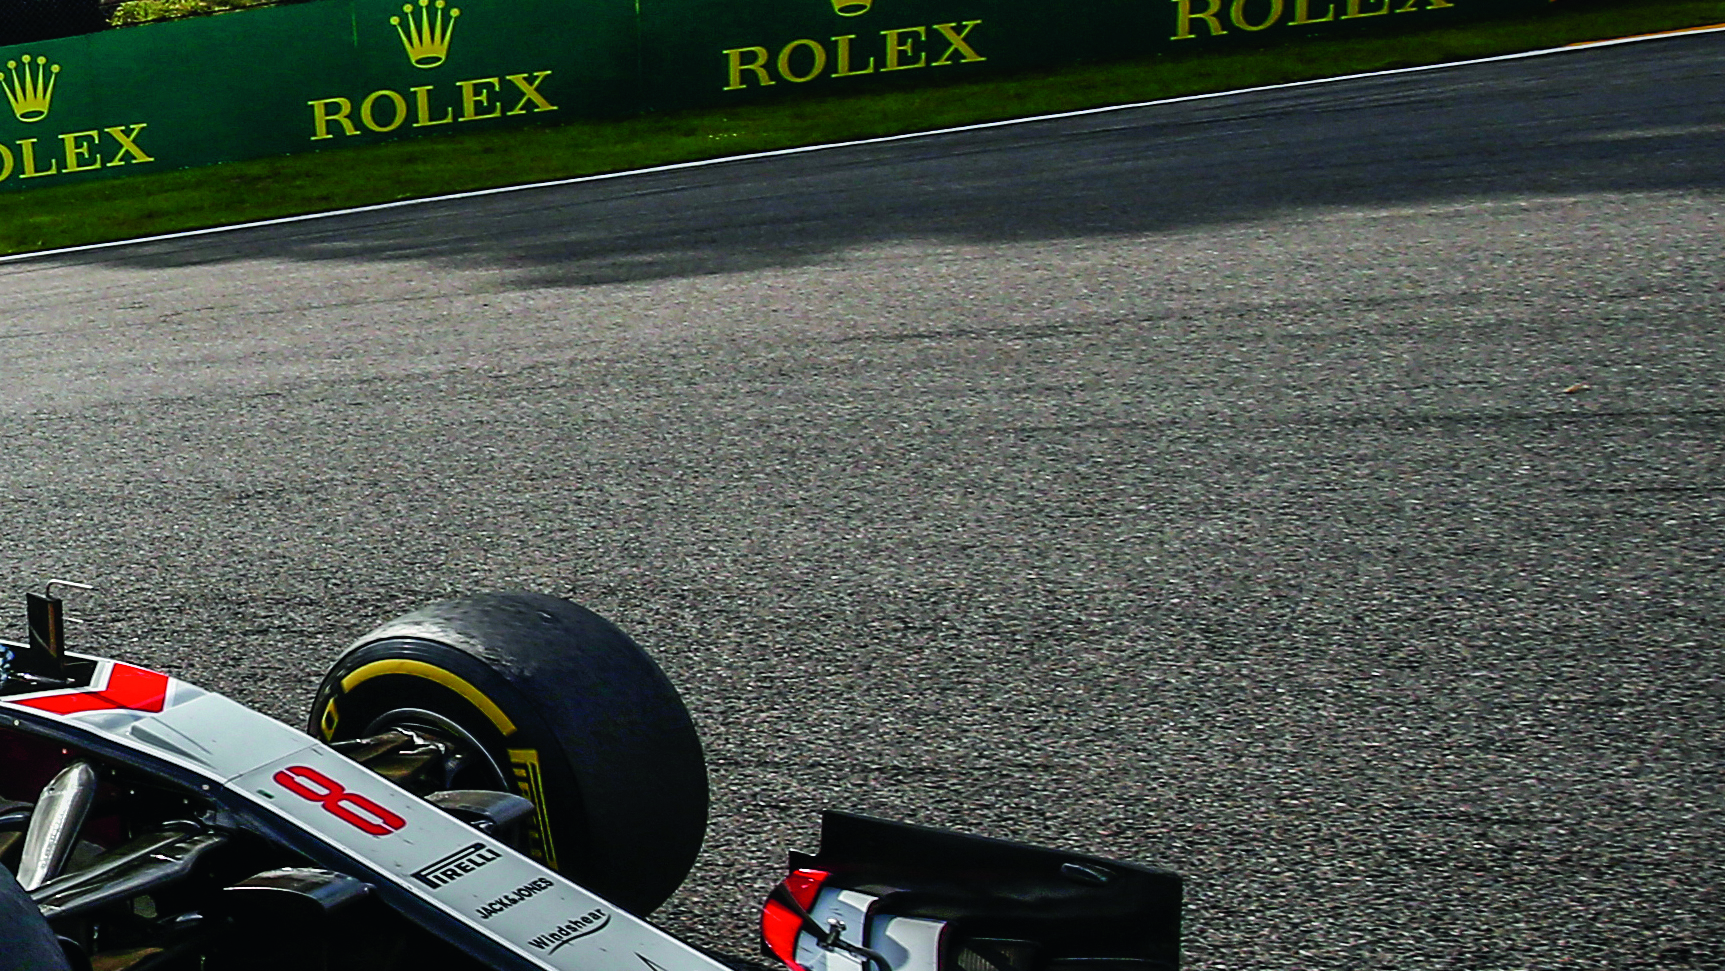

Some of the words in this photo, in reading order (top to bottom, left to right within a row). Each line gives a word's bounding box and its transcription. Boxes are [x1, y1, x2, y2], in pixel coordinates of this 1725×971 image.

[722, 19, 988, 91] ROLEX
[307, 69, 559, 140] ROLEX
[274, 766, 406, 836] 8
[411, 842, 503, 890] PIRELLI
[475, 877, 555, 921] JACK&JONES
[528, 908, 607, 950] Windshear
